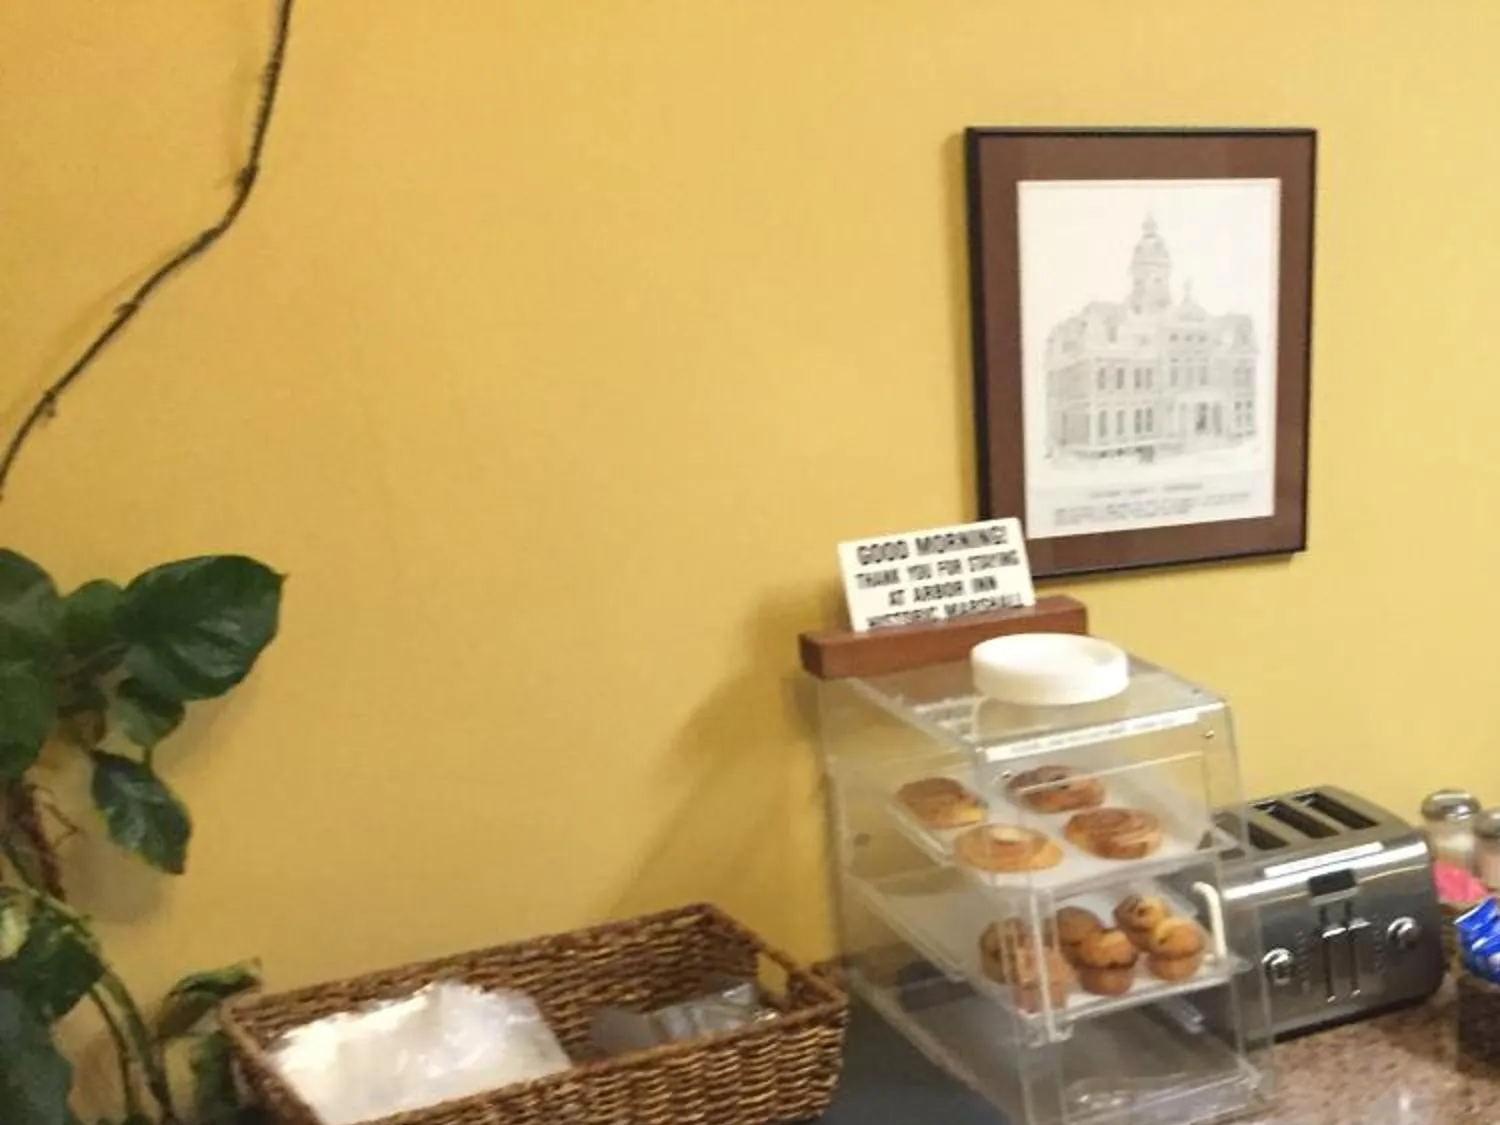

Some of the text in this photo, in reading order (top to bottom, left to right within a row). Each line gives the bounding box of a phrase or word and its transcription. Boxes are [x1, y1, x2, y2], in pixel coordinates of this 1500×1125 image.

[856, 540, 909, 566] GOOD
[855, 568, 899, 589] THANK
[906, 563, 932, 580] YOU
[937, 559, 962, 576] FOR
[888, 575, 998, 606] AT ARBOR INN
